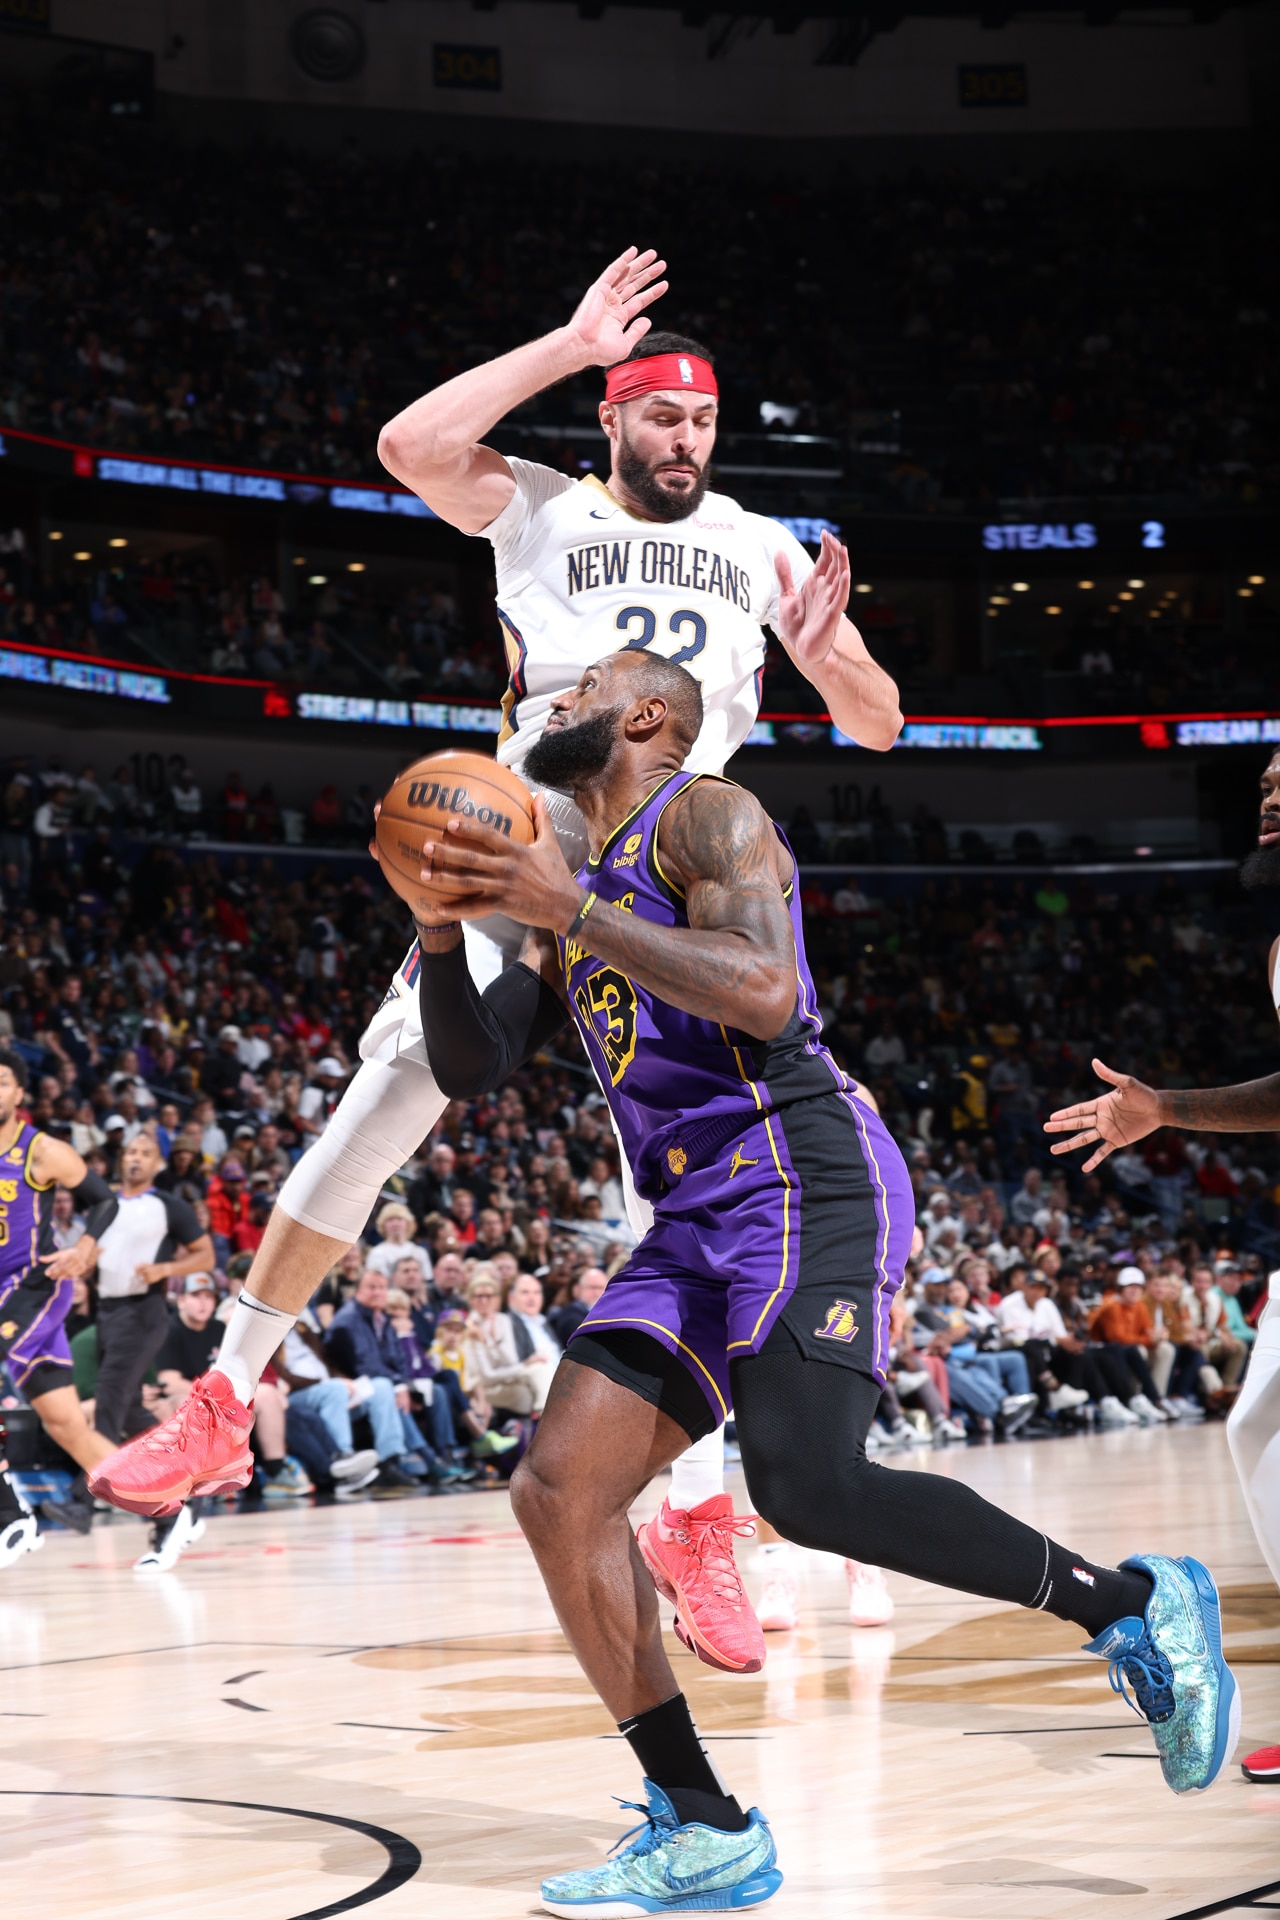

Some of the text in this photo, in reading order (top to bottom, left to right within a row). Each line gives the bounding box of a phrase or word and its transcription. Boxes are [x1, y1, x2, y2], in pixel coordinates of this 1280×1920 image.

[436, 52, 498, 83] 304
[963, 71, 1024, 101] 305
[98, 458, 167, 486] STREAM
[169, 466, 198, 491] ALL
[200, 470, 232, 495] THE
[234, 475, 286, 501] LOCAL
[982, 521, 1166, 550] STEALS 2
[566, 540, 751, 613] NEW ORLEANS
[614, 604, 708, 666] 22
[52, 659, 116, 694] PRETTY
[297, 693, 502, 733] STREAM ALL THE LOCA
[904, 724, 979, 748] PRETTY
[1177, 720, 1260, 746] STREAM
[407, 782, 513, 838] Wilson
[829, 784, 889, 823] 104
